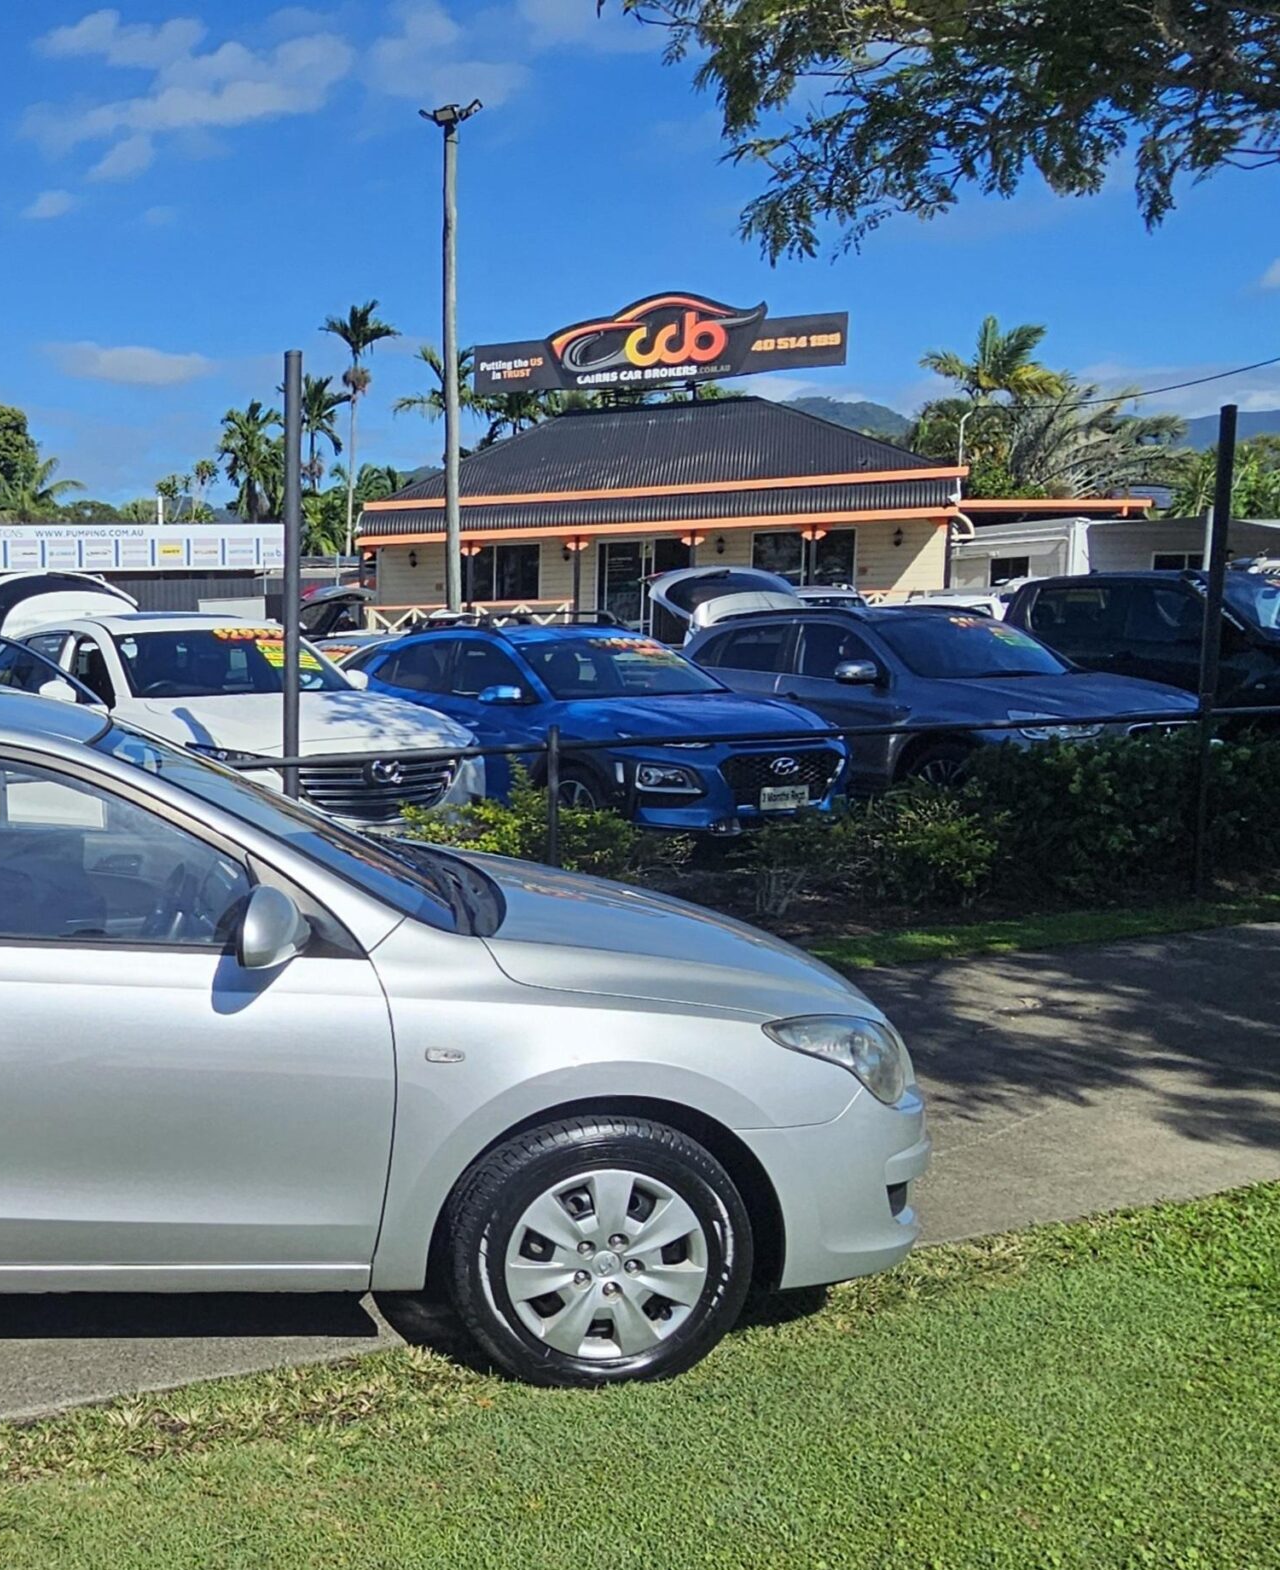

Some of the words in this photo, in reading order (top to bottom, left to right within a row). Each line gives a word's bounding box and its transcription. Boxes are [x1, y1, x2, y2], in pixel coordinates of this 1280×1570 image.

[480, 360, 513, 371] Putting
[513, 359, 529, 369] the
[529, 357, 543, 367] US
[502, 368, 532, 379] TRUST
[576, 371, 618, 384] CAIRNS
[620, 369, 642, 381] CAR
[35, 529, 144, 537] WWW.PUMPING.COM.AU
